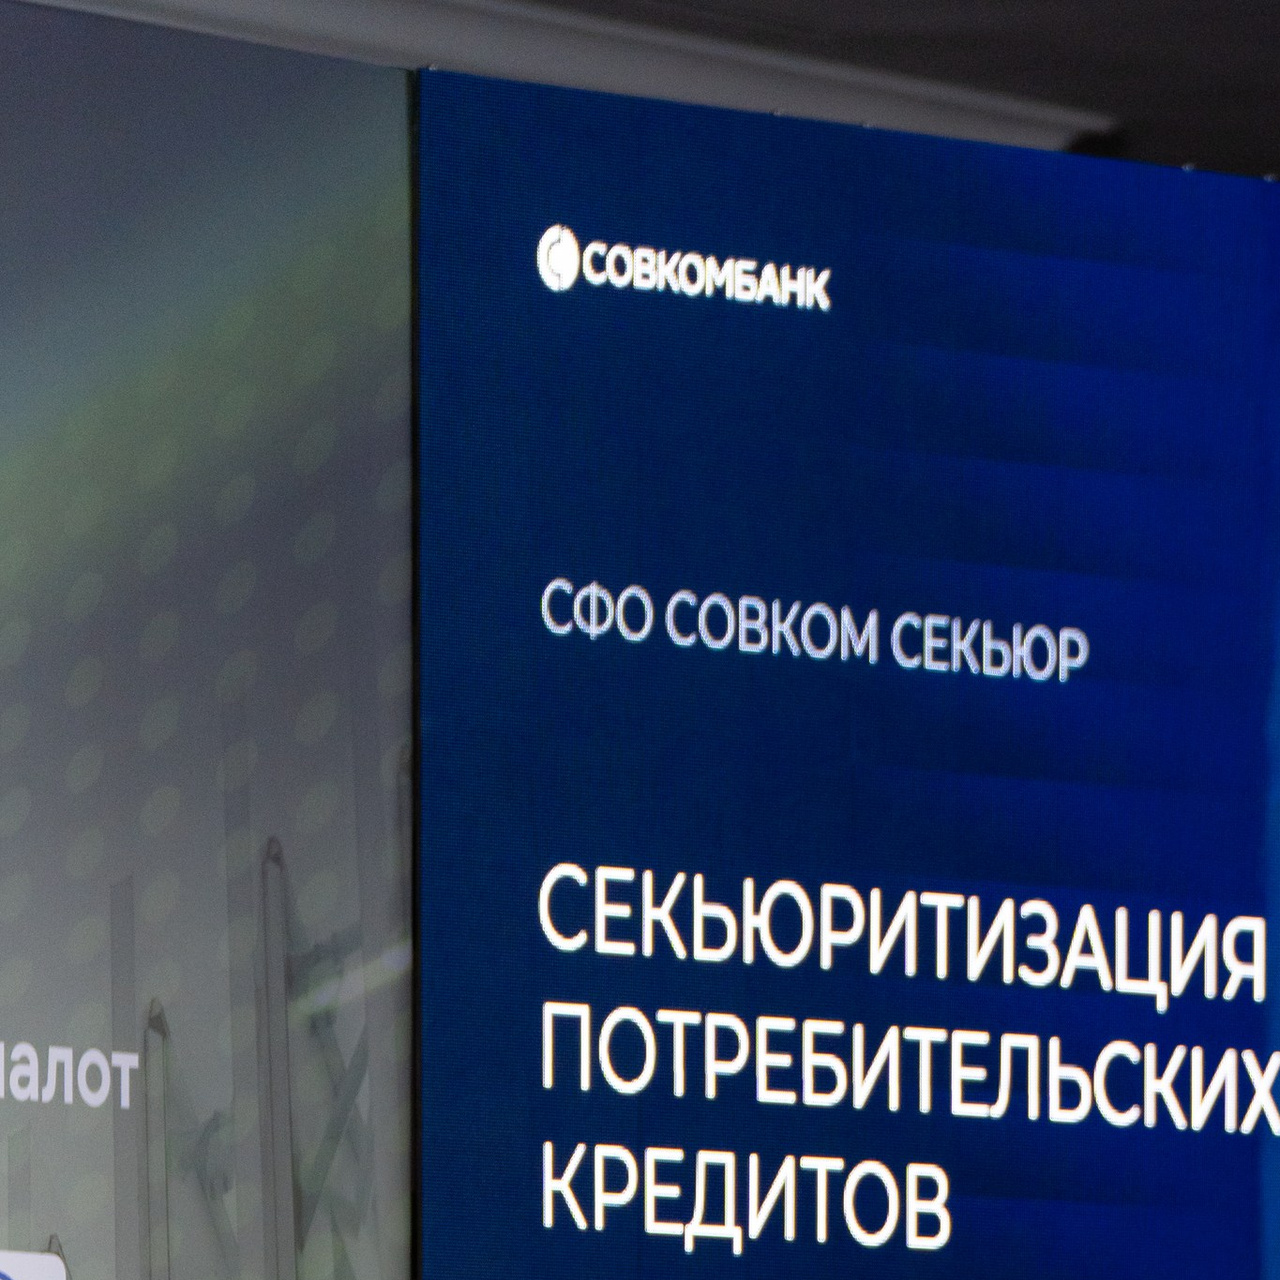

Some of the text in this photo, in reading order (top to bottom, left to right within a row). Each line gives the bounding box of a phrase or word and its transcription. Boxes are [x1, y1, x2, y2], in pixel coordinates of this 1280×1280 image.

[581, 240, 832, 312] СОВКОМБАНК
[540, 577, 1090, 683] СФО СОВКОМ СЕКЬЮР
[537, 862, 1267, 1015] СЕКЬЮРИТИЗАЦИЯ
[542, 1140, 952, 1256] КРЕДИТОВ
